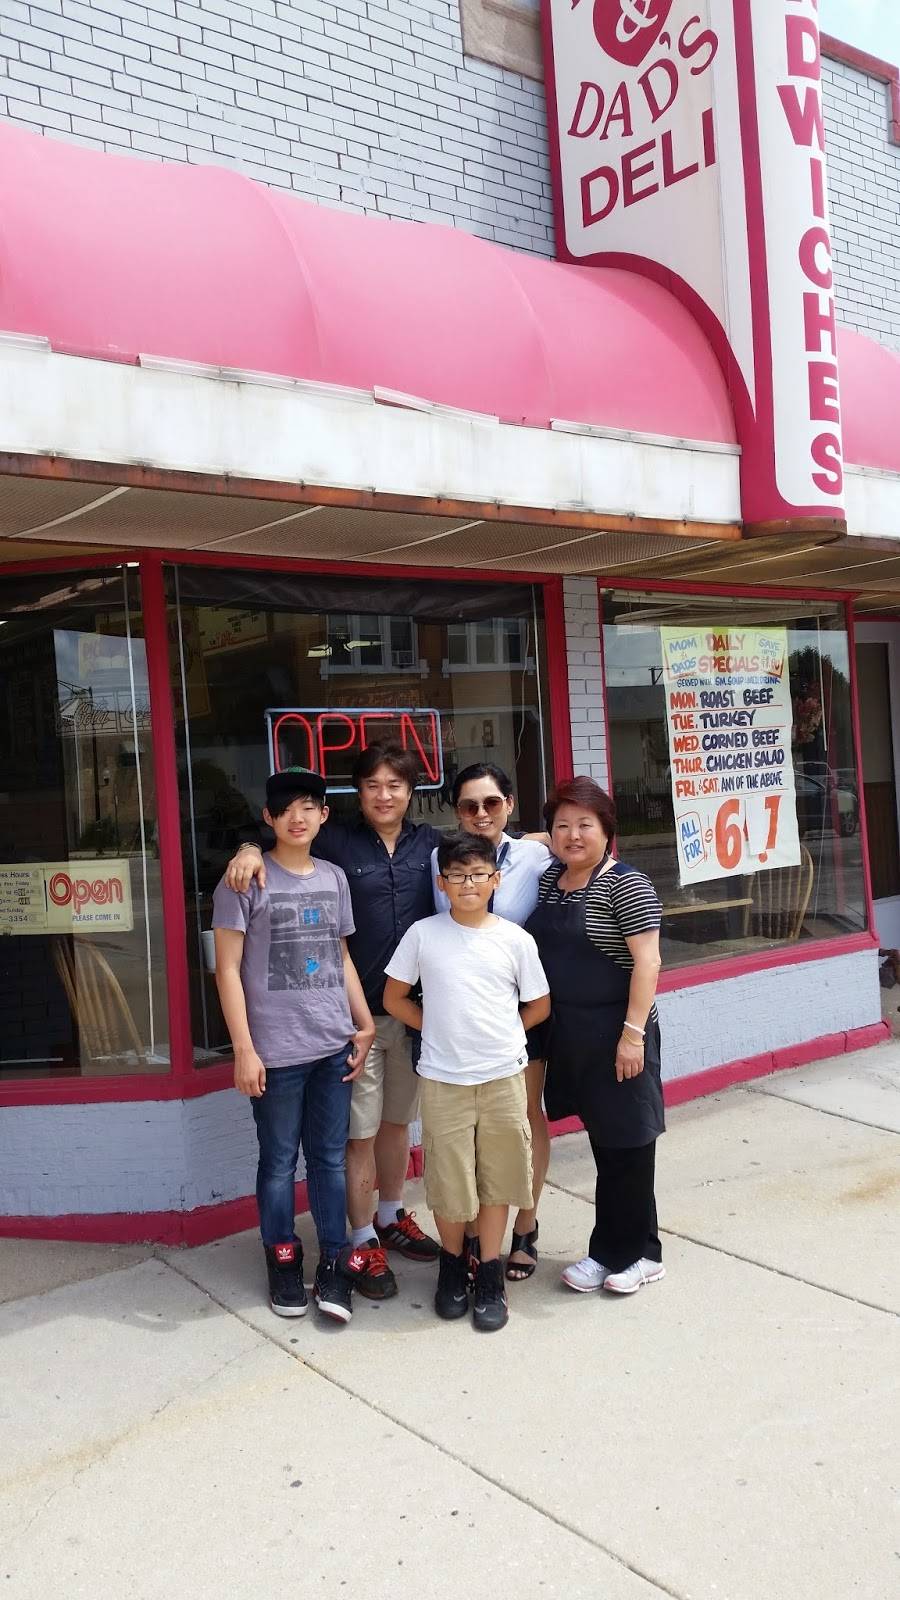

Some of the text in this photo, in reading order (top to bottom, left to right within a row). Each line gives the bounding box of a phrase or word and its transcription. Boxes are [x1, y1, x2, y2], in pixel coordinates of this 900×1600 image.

[615, 0, 658, 42] &
[567, 15, 719, 140] DAD'S
[580, 107, 716, 228] DELI
[776, 0, 843, 495] DWICHES
[669, 637, 698, 653] MOM
[705, 632, 746, 652] DAILY
[758, 638, 781, 651] SAVE
[671, 656, 697, 673] DADS
[698, 655, 760, 673] SPECIALS
[677, 678, 699, 688] SERVED
[670, 687, 774, 709] MON. ROAST BEEF
[671, 709, 757, 730] TUE. TURKEY
[673, 728, 779, 753] WED. CORNED BEEF
[672, 748, 785, 774] THUR. CHICKEN SALAD
[675, 777, 699, 798] FRI.
[721, 774, 735, 792] ANY
[736, 773, 744, 789] OF
[745, 773, 758, 789] THE
[760, 770, 783, 788] ABOVE
[681, 819, 699, 842] ALL
[684, 838, 702, 863] FOR
[49, 872, 123, 914] Open
[72, 914, 94, 922] PLEASE
[95, 913, 112, 921] COME
